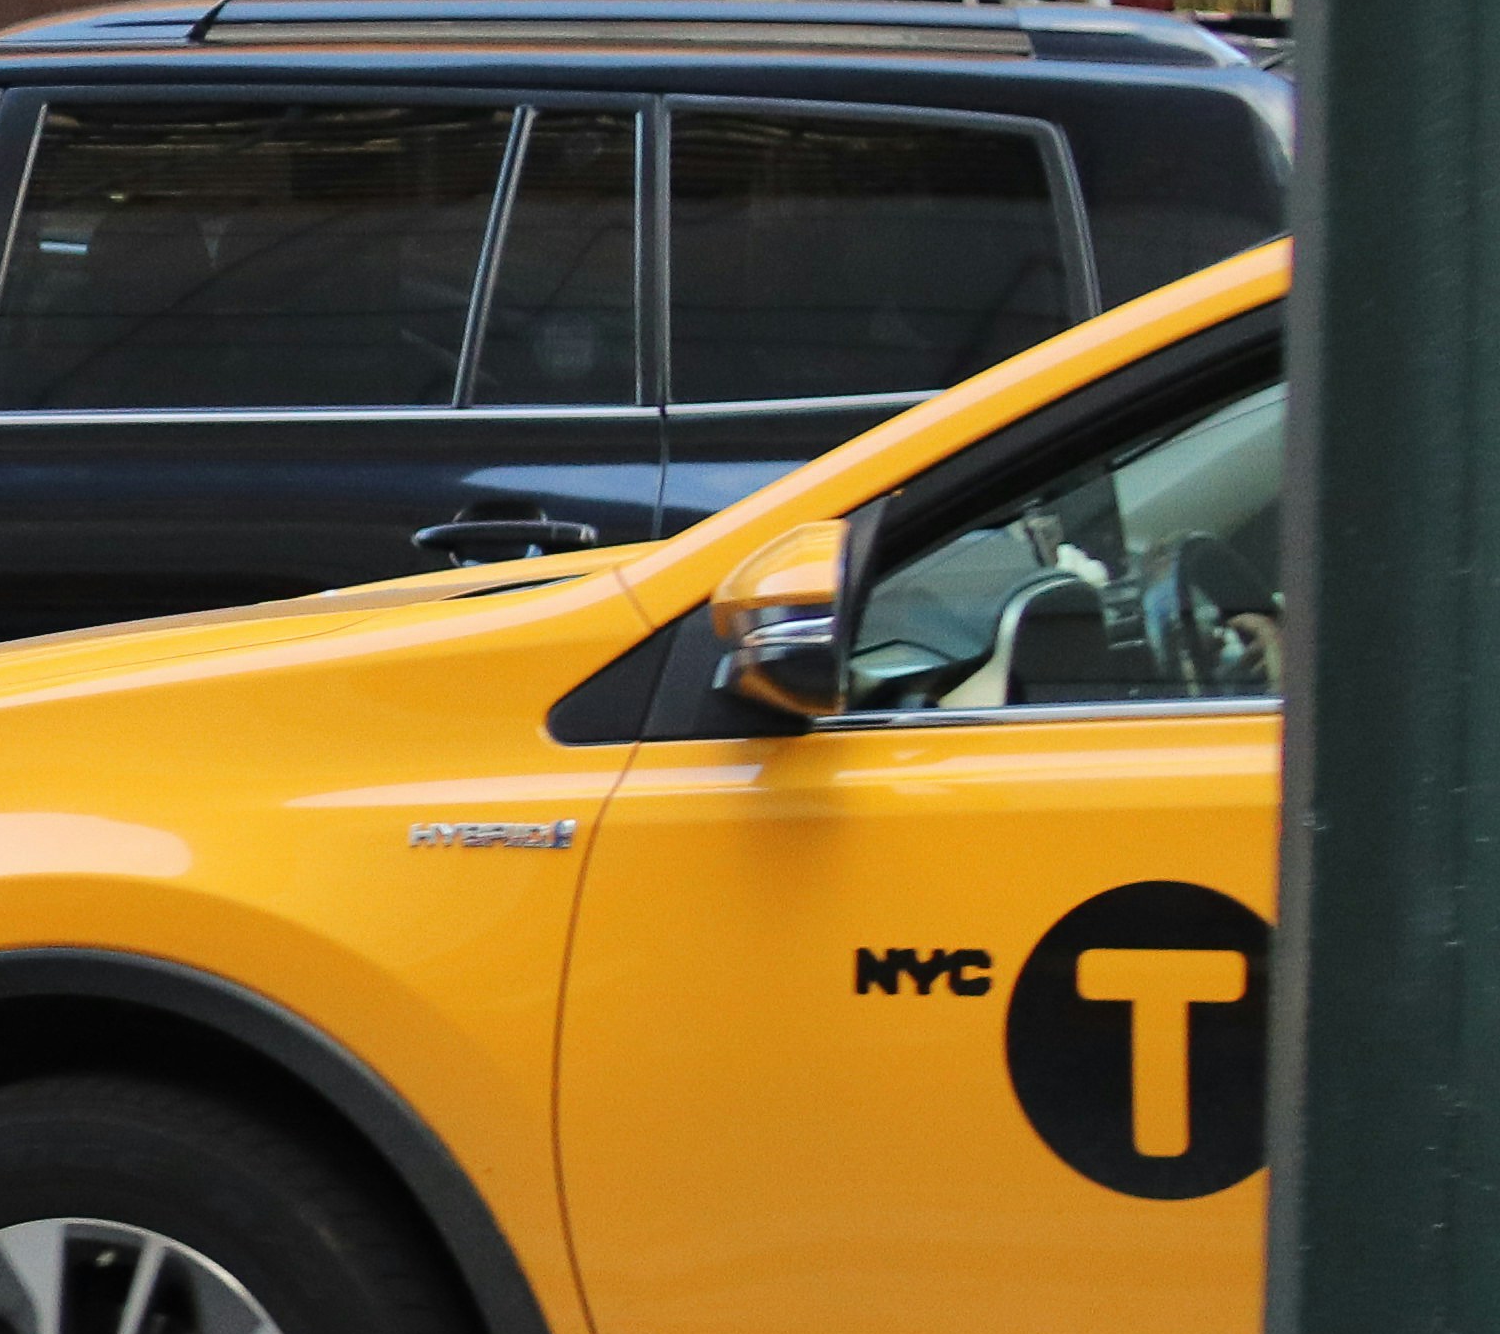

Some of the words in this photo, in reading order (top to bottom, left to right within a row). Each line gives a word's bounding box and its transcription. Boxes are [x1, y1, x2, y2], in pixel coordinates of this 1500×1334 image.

[409, 822, 556, 849] HYBRID
[853, 947, 993, 997] NYC
[1076, 947, 1248, 1159] T
